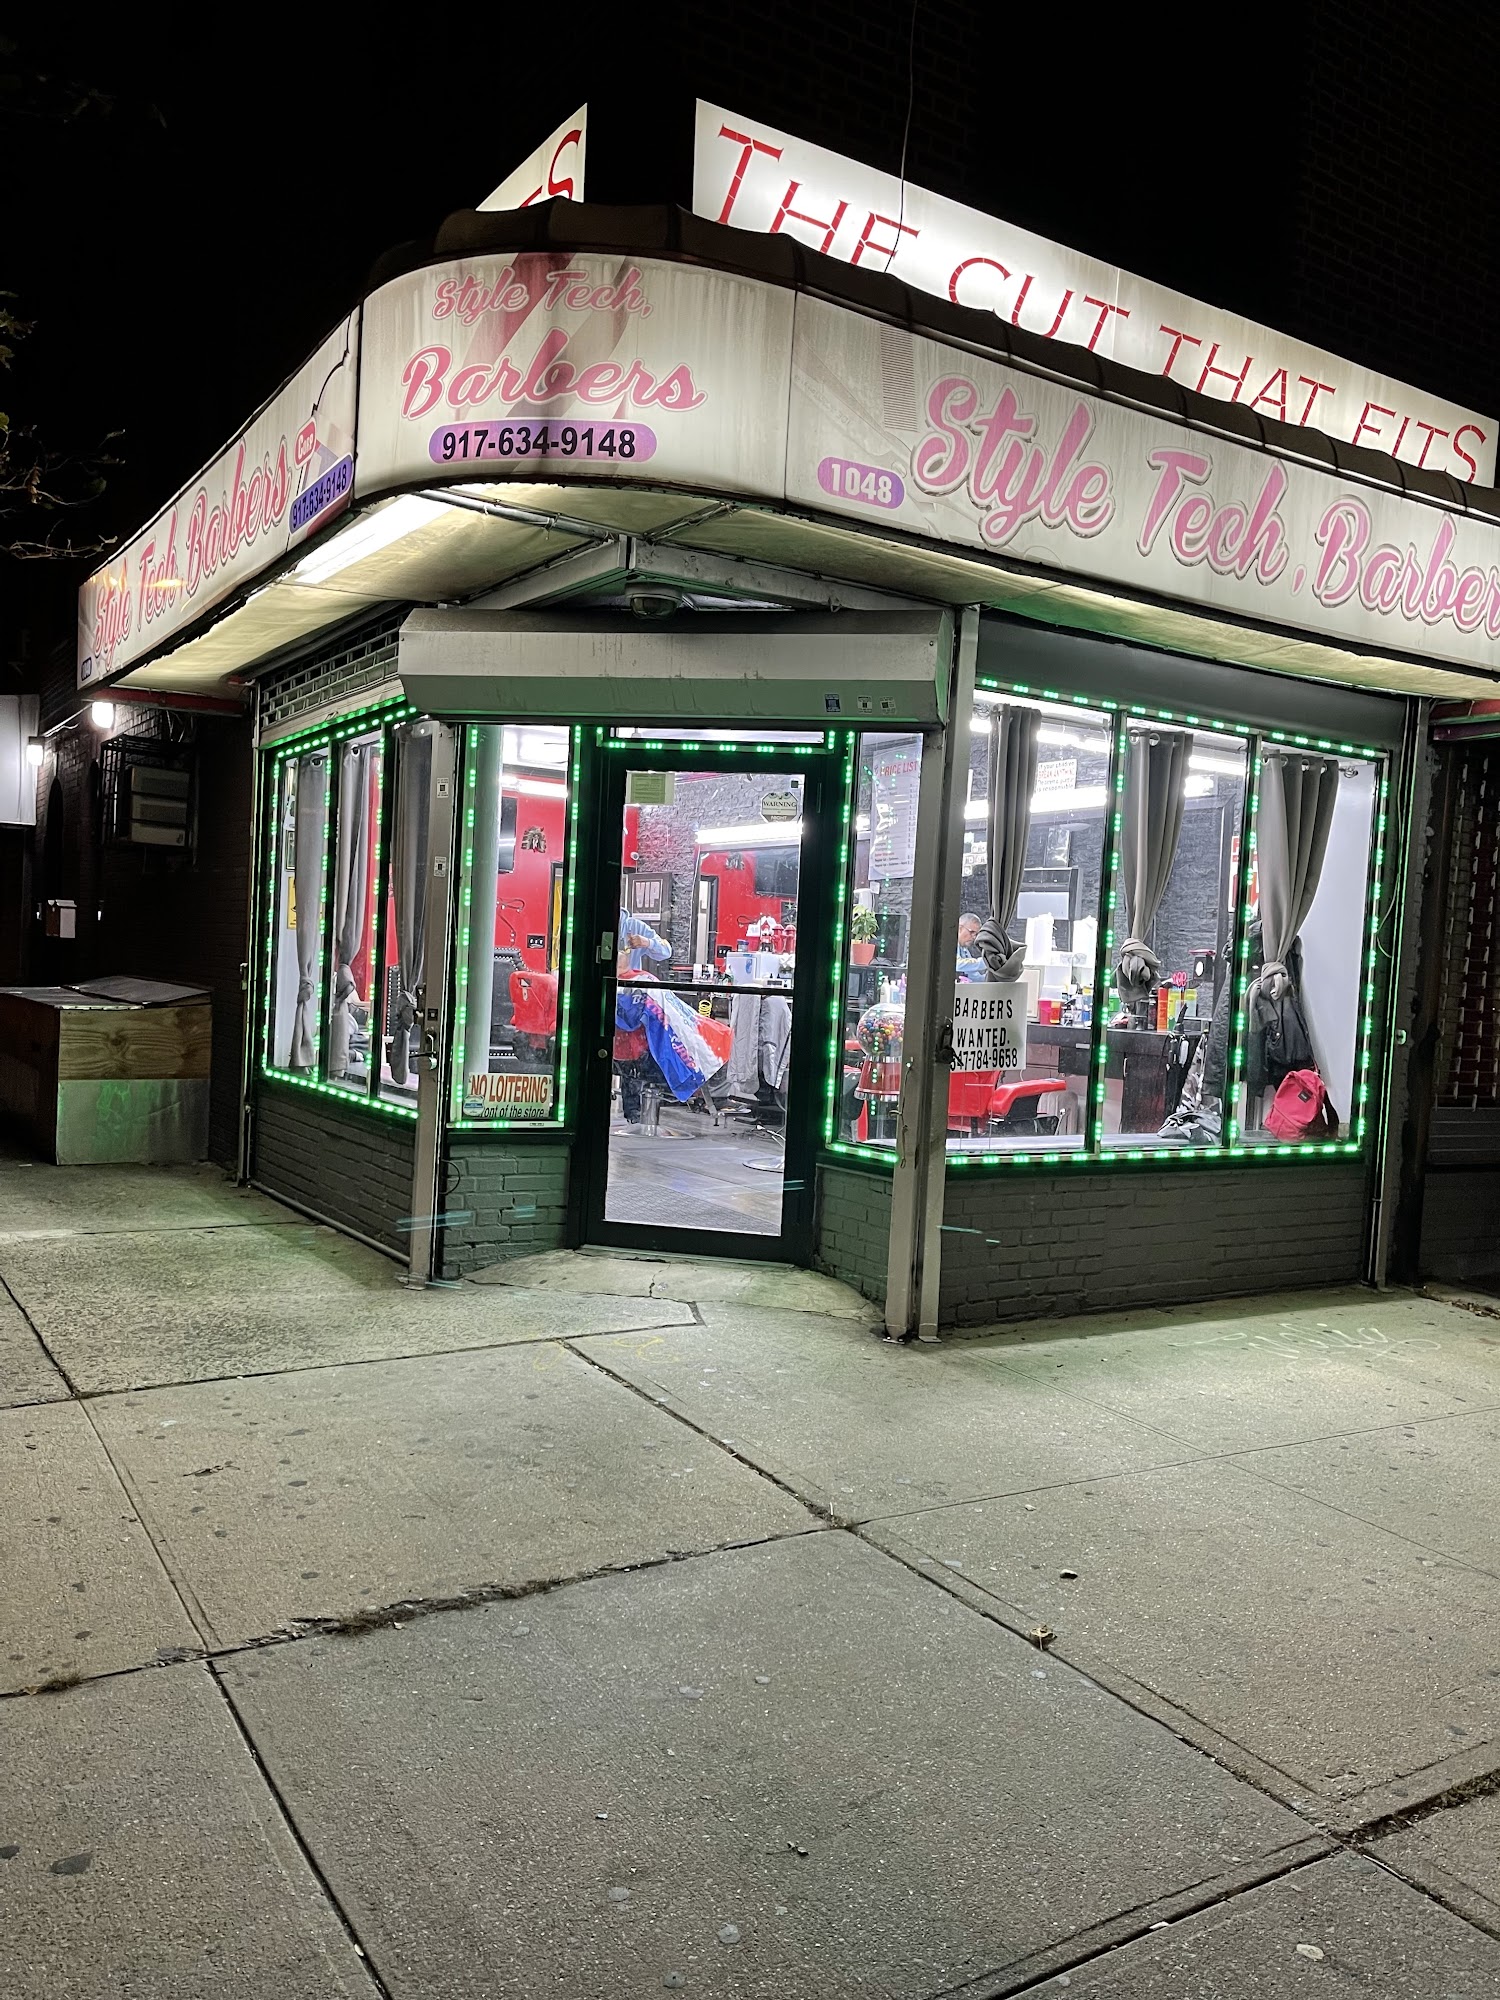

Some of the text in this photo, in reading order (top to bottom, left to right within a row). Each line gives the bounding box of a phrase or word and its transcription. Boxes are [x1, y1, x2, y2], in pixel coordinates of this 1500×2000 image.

[432, 265, 654, 325] Style Tech,
[401, 328, 708, 420] Barbers
[948, 256, 1131, 351] CUT
[1158, 323, 1337, 429] THAT
[1351, 400, 1487, 483] FITS
[441, 426, 637, 461] 917-634-9148
[910, 371, 1116, 549] Style
[831, 463, 892, 504] 1048
[94, 556, 132, 671] Style
[186, 434, 293, 598] Barbers
[902, 760, 918, 774] LIST
[763, 800, 798, 808] WARNING
[635, 881, 660, 908] VIP
[954, 997, 1013, 1020] BARBERS
[957, 1027, 1010, 1048] WANTED.
[510, 1104, 525, 1118] the
[526, 1104, 545, 1118] store
